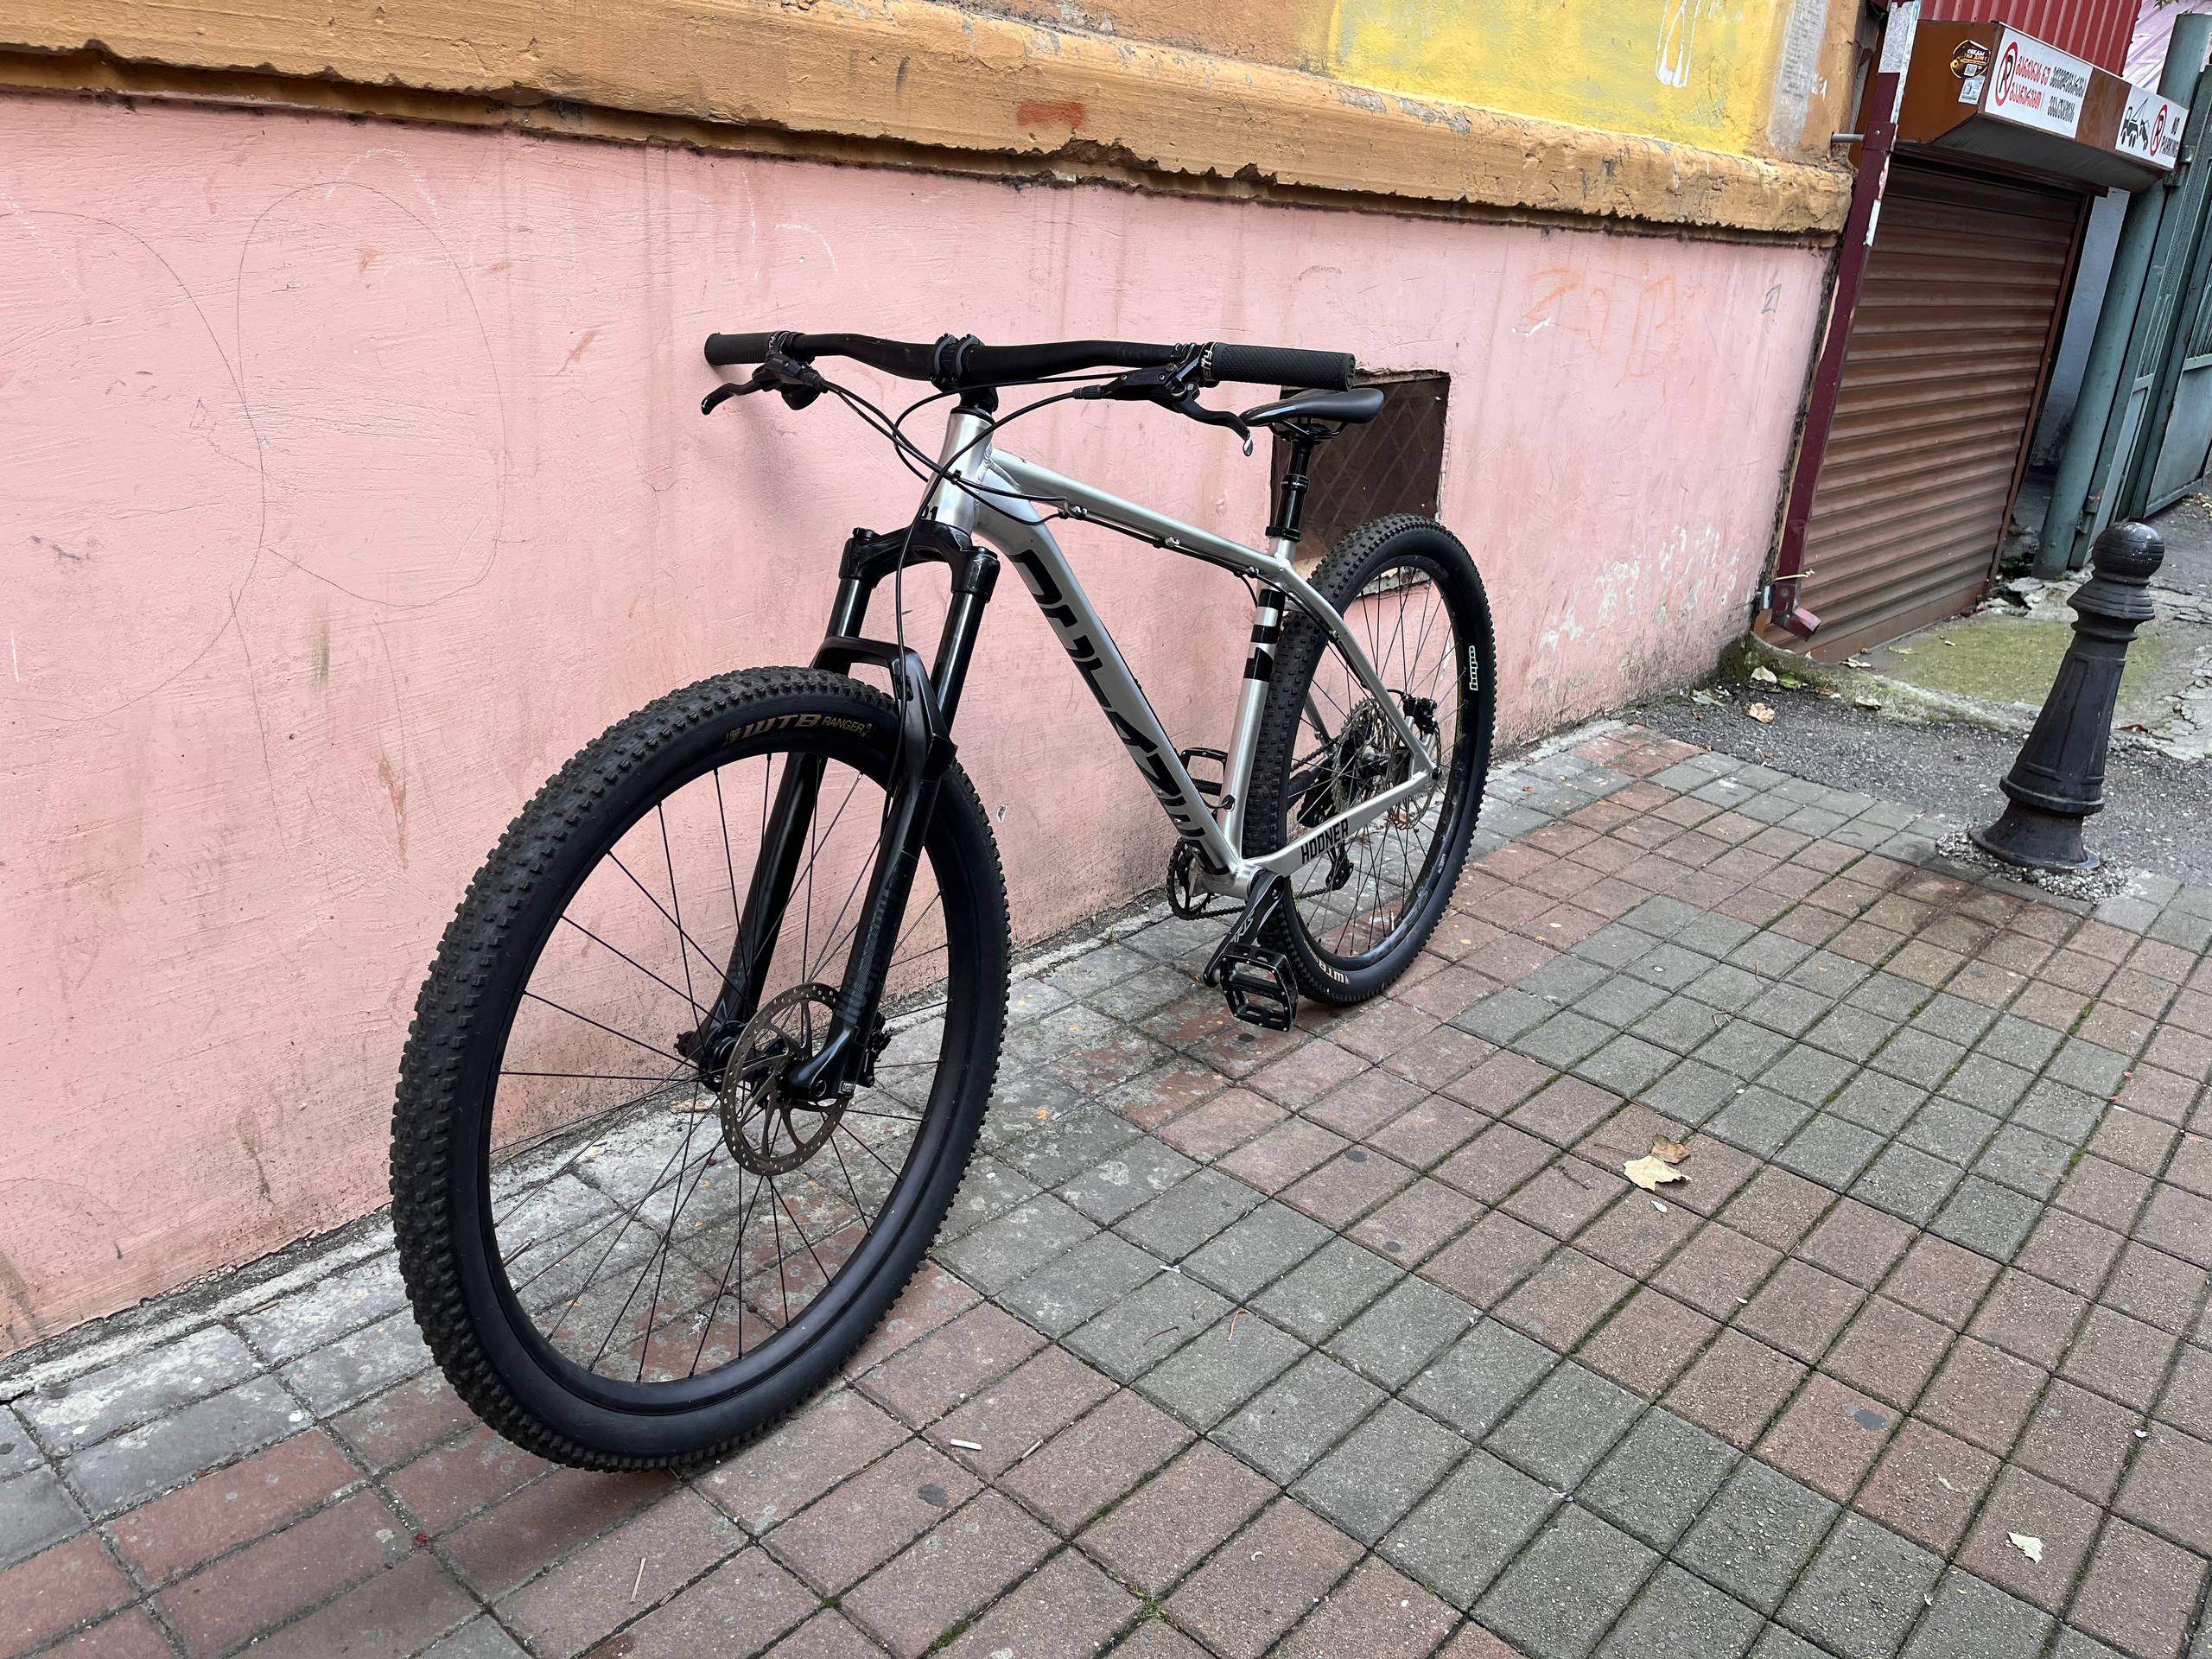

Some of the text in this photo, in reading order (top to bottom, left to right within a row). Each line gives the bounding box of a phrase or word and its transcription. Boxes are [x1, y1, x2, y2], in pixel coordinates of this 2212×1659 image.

[1469, 645, 1478, 691] hope
[742, 713, 822, 739] WTB
[822, 715, 865, 734] RANGER
[1300, 817, 1350, 863] HOONER
